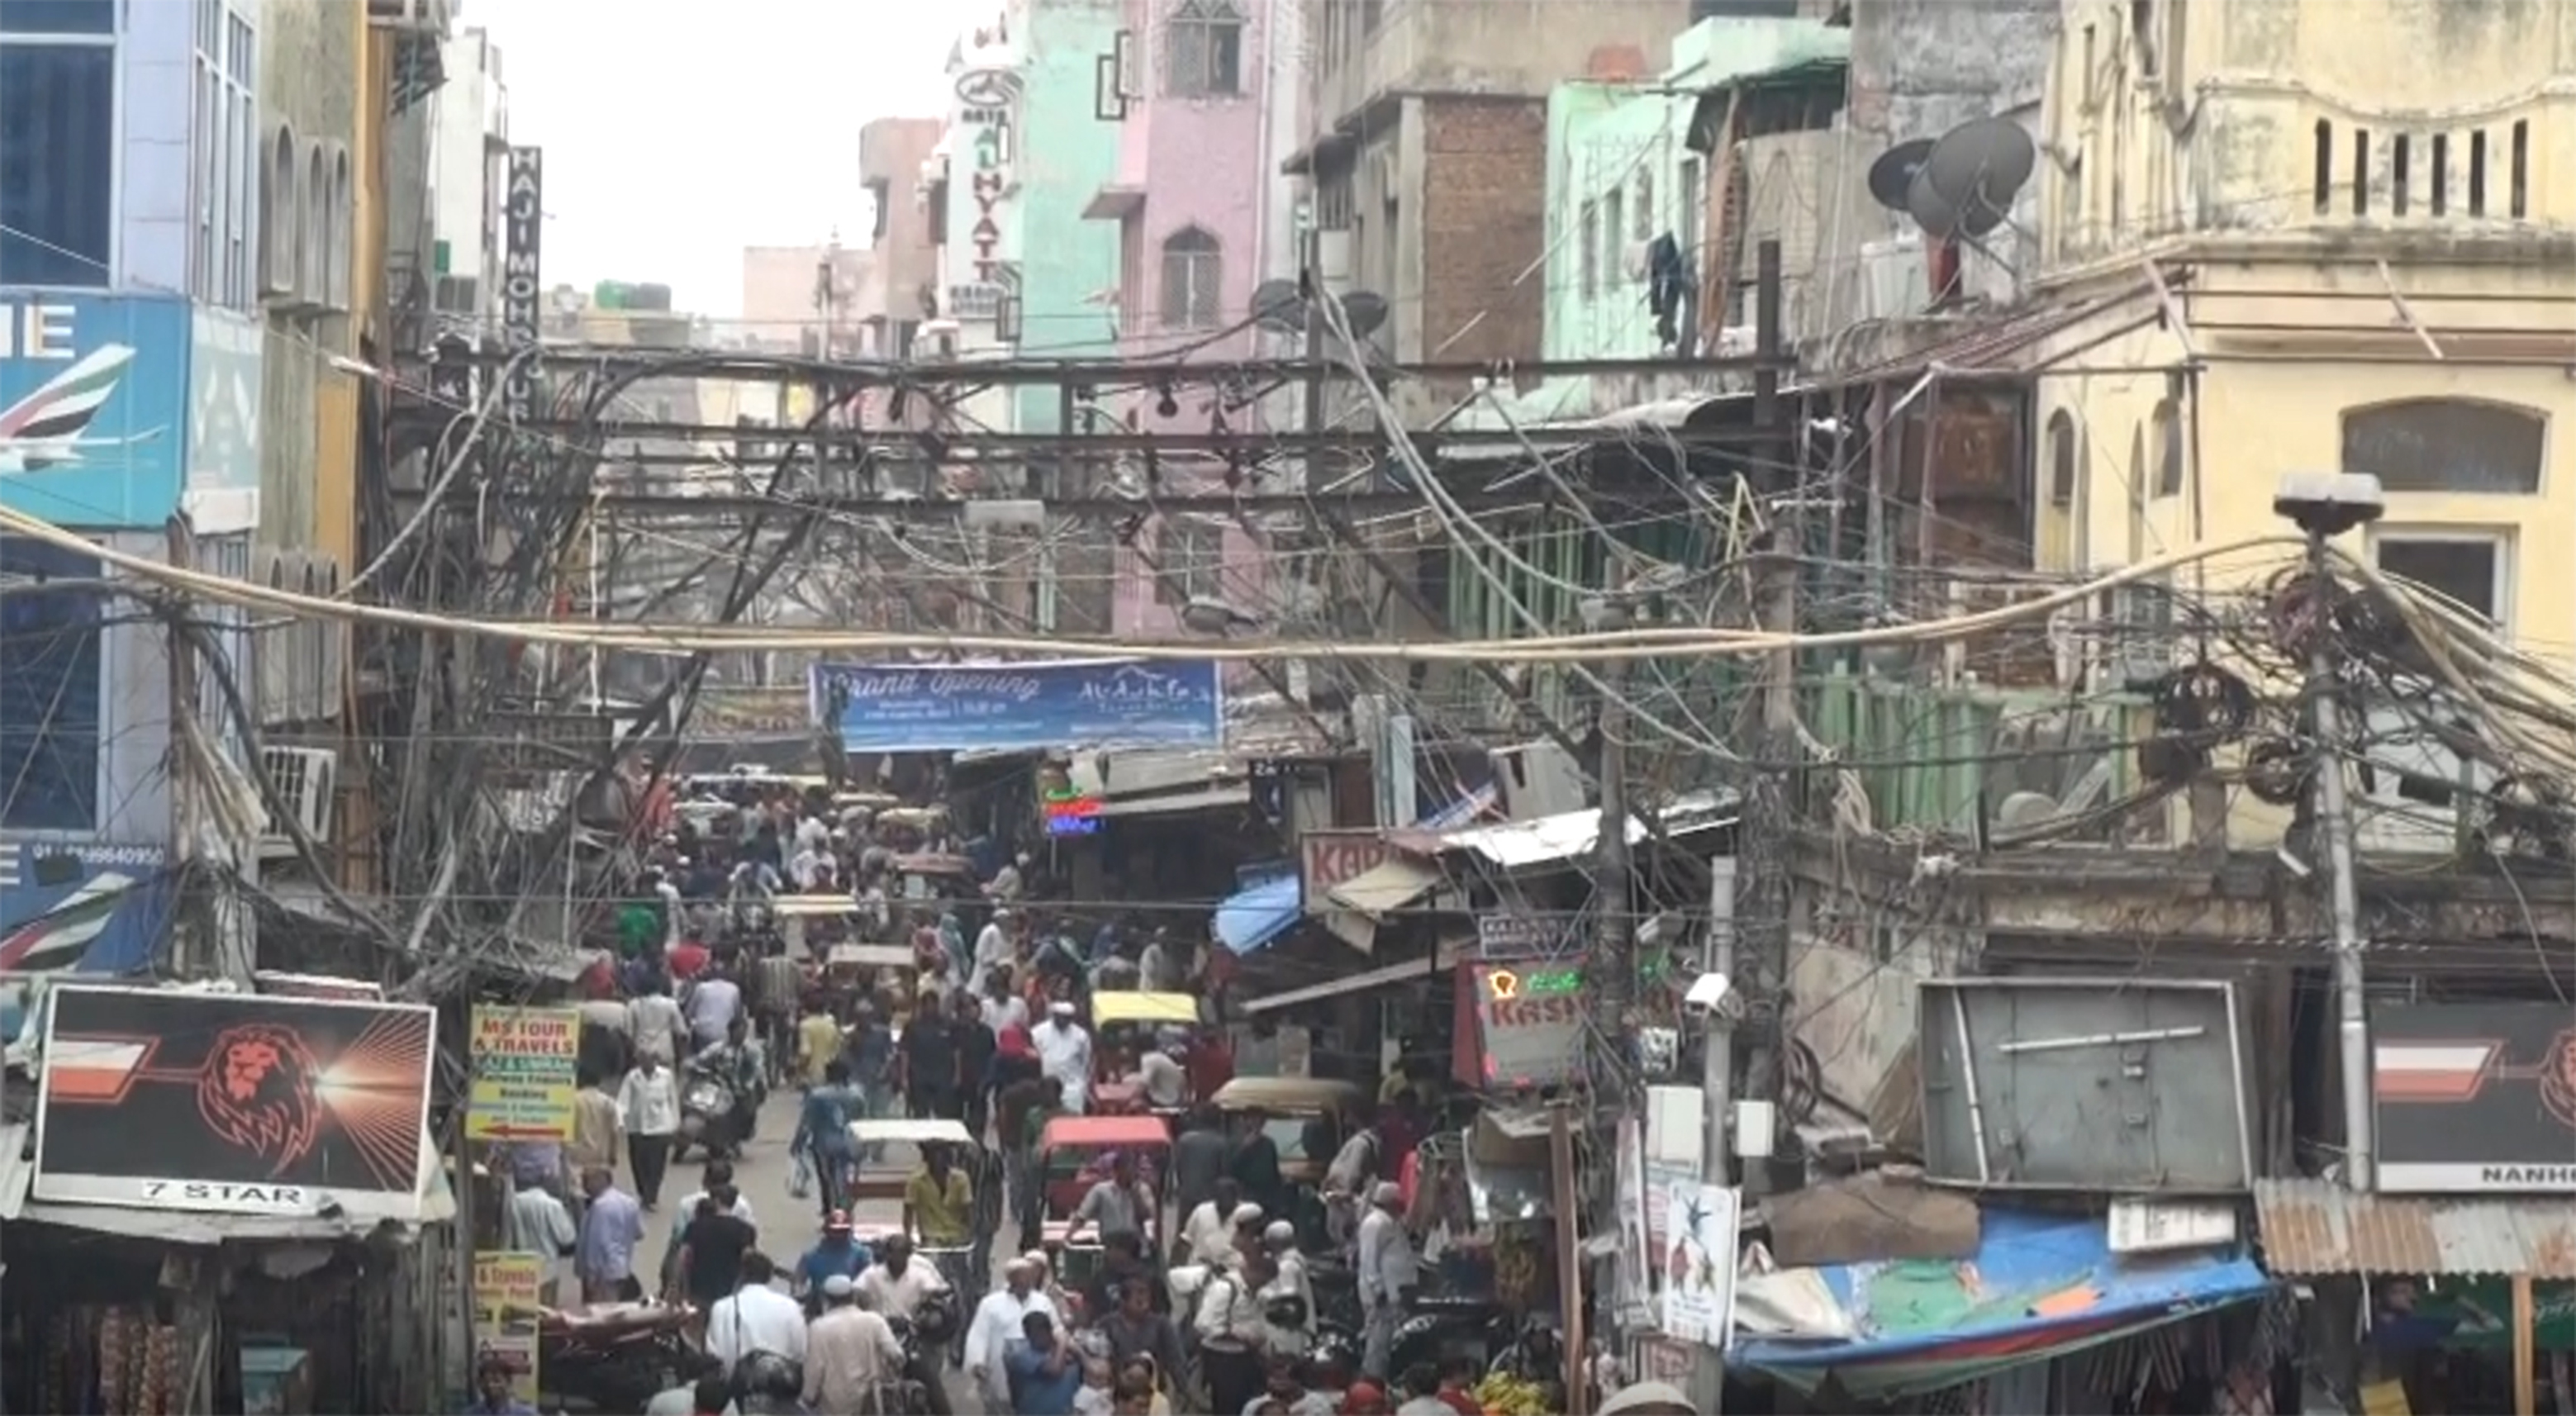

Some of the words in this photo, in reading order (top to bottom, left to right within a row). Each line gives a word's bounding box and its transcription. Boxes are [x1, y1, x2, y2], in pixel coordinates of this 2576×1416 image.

[512, 150, 537, 245] HAJI
[972, 172, 1001, 282] HYATT
[0, 305, 75, 359] E
[929, 671, 1042, 701] Opening
[520, 1020, 567, 1036] TOUR
[495, 1038, 574, 1053] TRAVELS
[146, 1182, 166, 1196] 7
[184, 1184, 301, 1204] STAR
